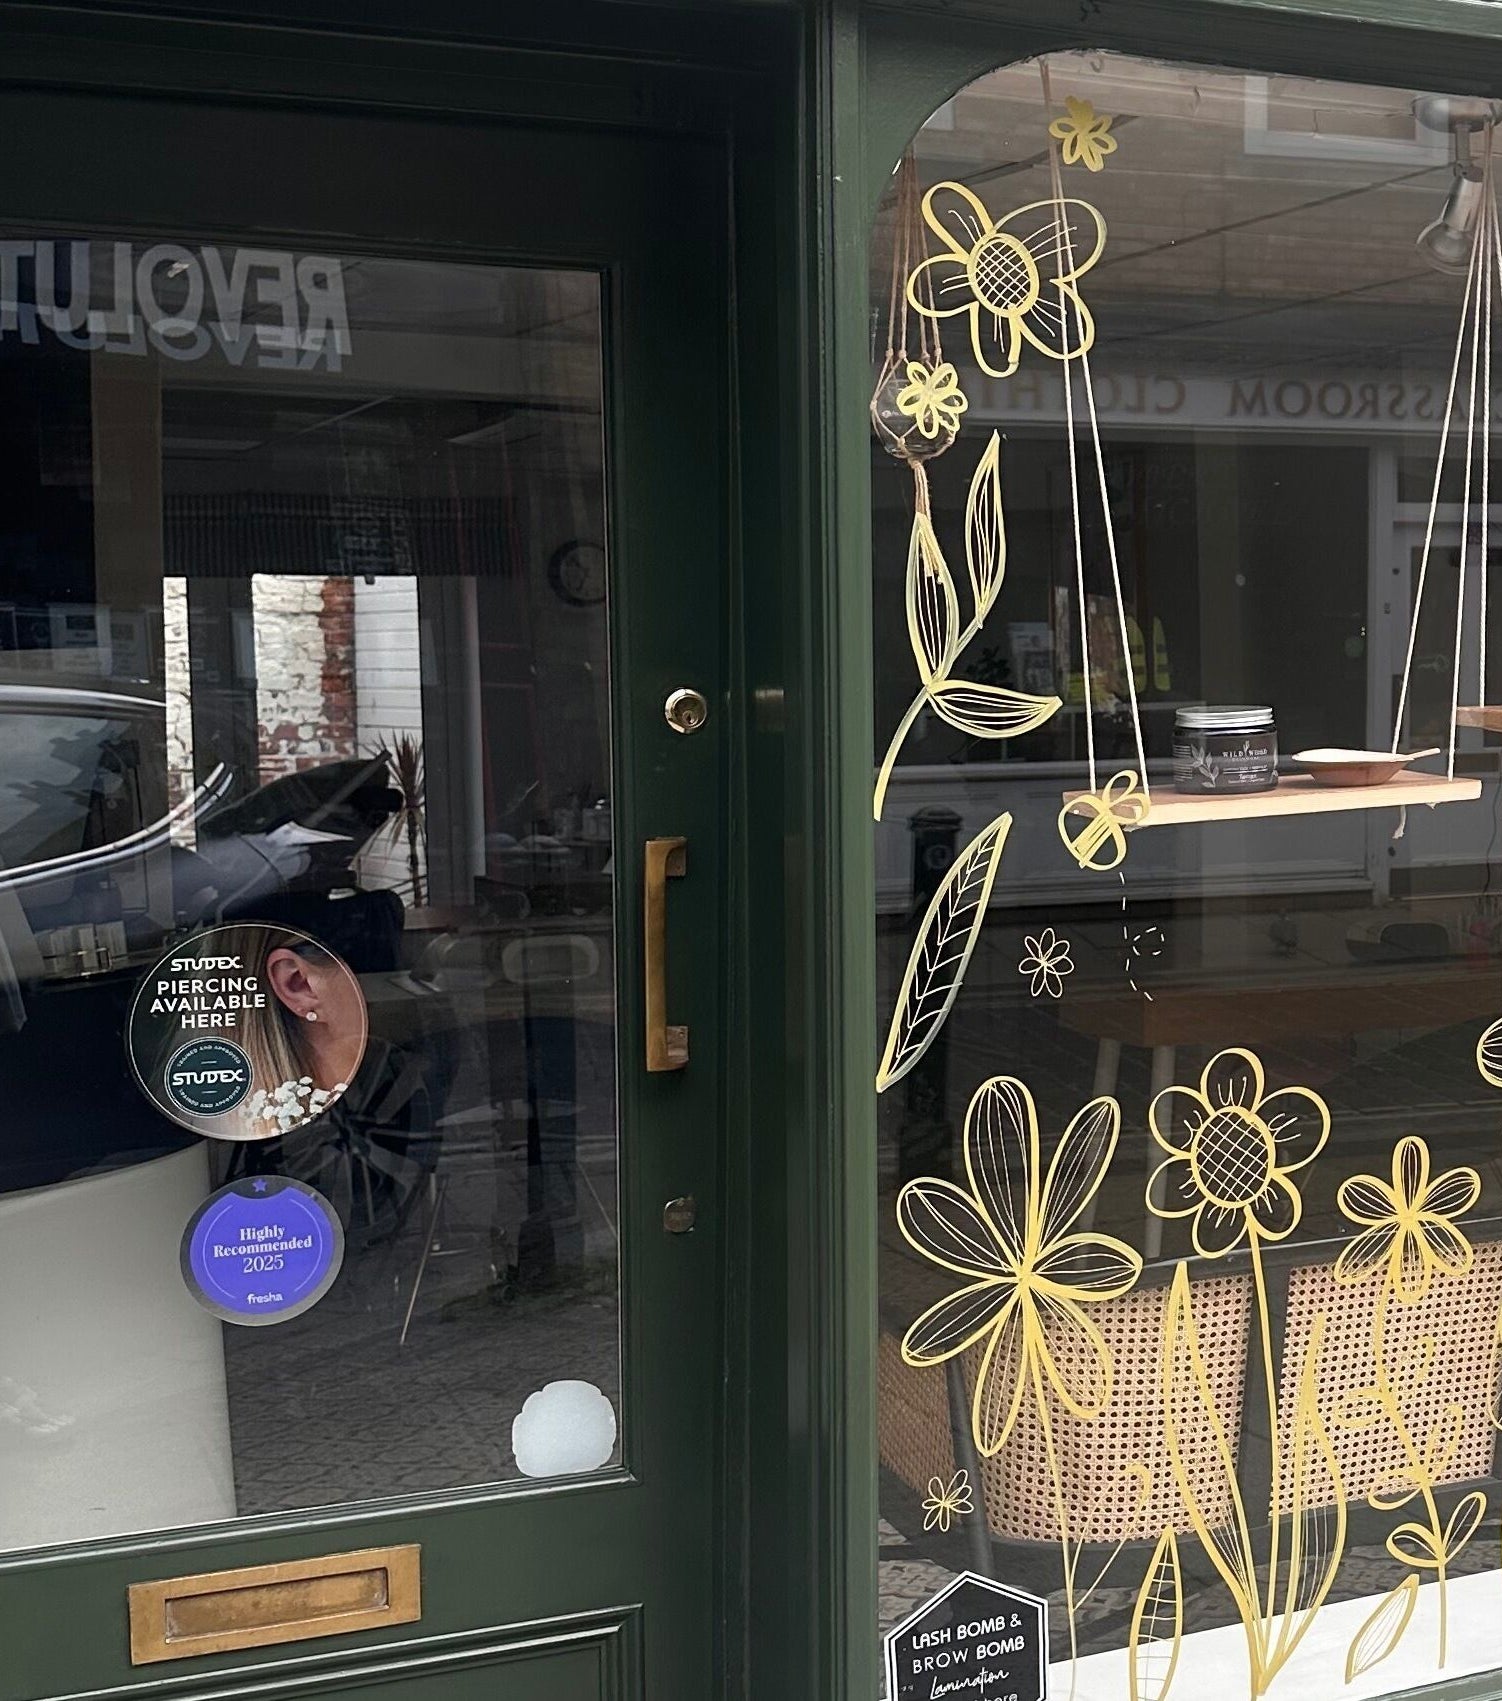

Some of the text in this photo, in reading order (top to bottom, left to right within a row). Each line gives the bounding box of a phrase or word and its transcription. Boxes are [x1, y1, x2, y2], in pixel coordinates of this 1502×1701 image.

[1222, 750, 1244, 758] WILD
[170, 956, 243, 972] STUDEX
[157, 976, 258, 995] PIERCING
[150, 993, 266, 1014] AVAILABLE
[181, 1012, 236, 1029] HERE
[172, 1069, 244, 1086] STUDEX
[239, 1224, 285, 1242] Highly
[213, 1235, 313, 1258] Recommended
[243, 1255, 284, 1273] 2025
[247, 1292, 284, 1305] fresha
[912, 1613, 1022, 1650] LASH BOMB &
[912, 1636, 1025, 1674] BROW BOMB
[929, 1666, 1010, 1700] Lamination
